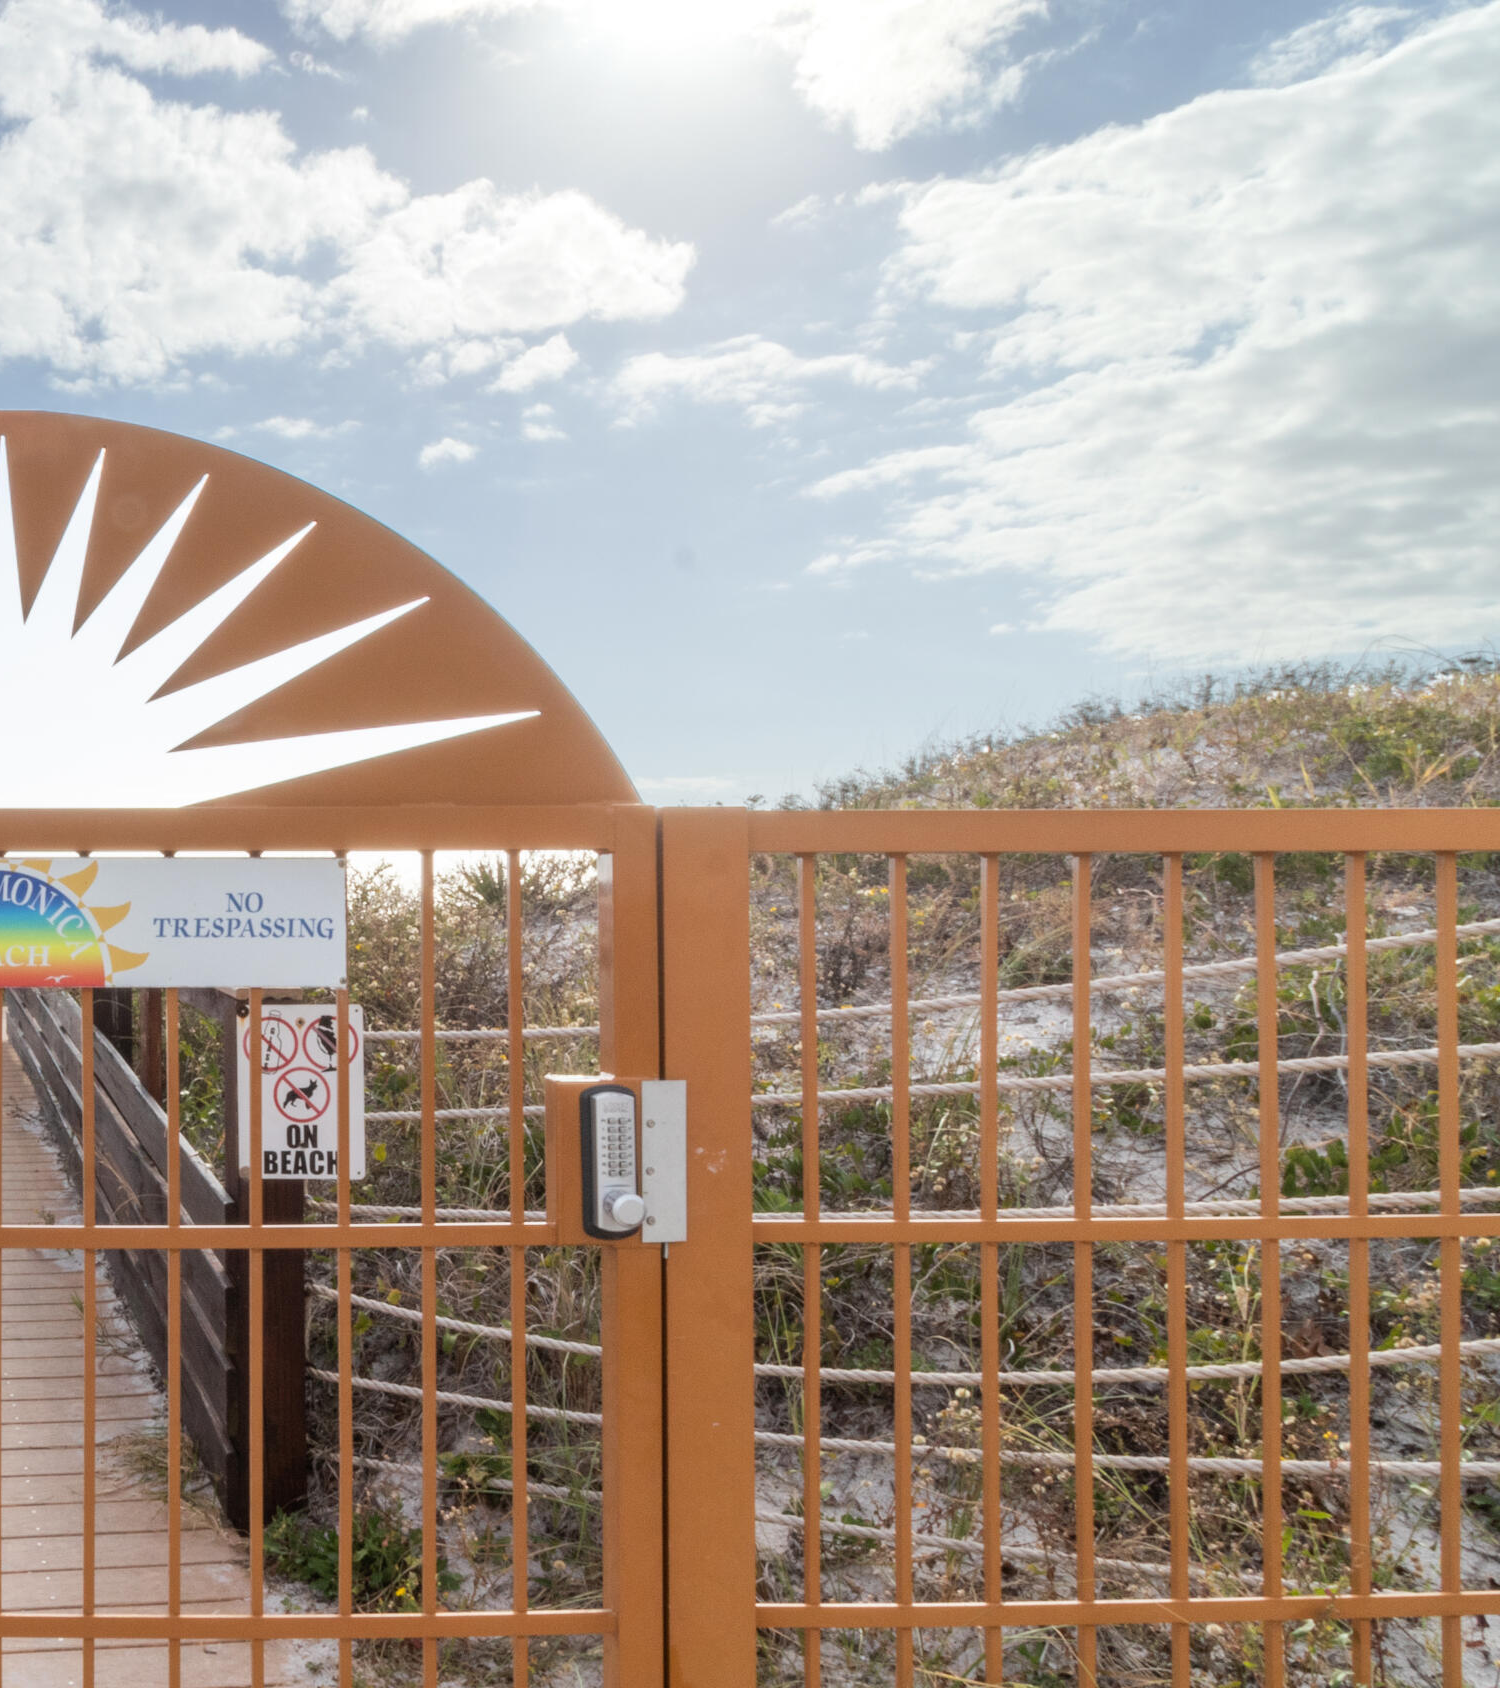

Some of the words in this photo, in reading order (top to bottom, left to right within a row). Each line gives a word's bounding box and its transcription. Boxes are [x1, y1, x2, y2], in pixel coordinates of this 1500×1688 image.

[225, 892, 264, 913] NO
[153, 918, 334, 940] TRESPASSING
[286, 1124, 319, 1149] ON
[263, 1150, 338, 1176] BEACH
